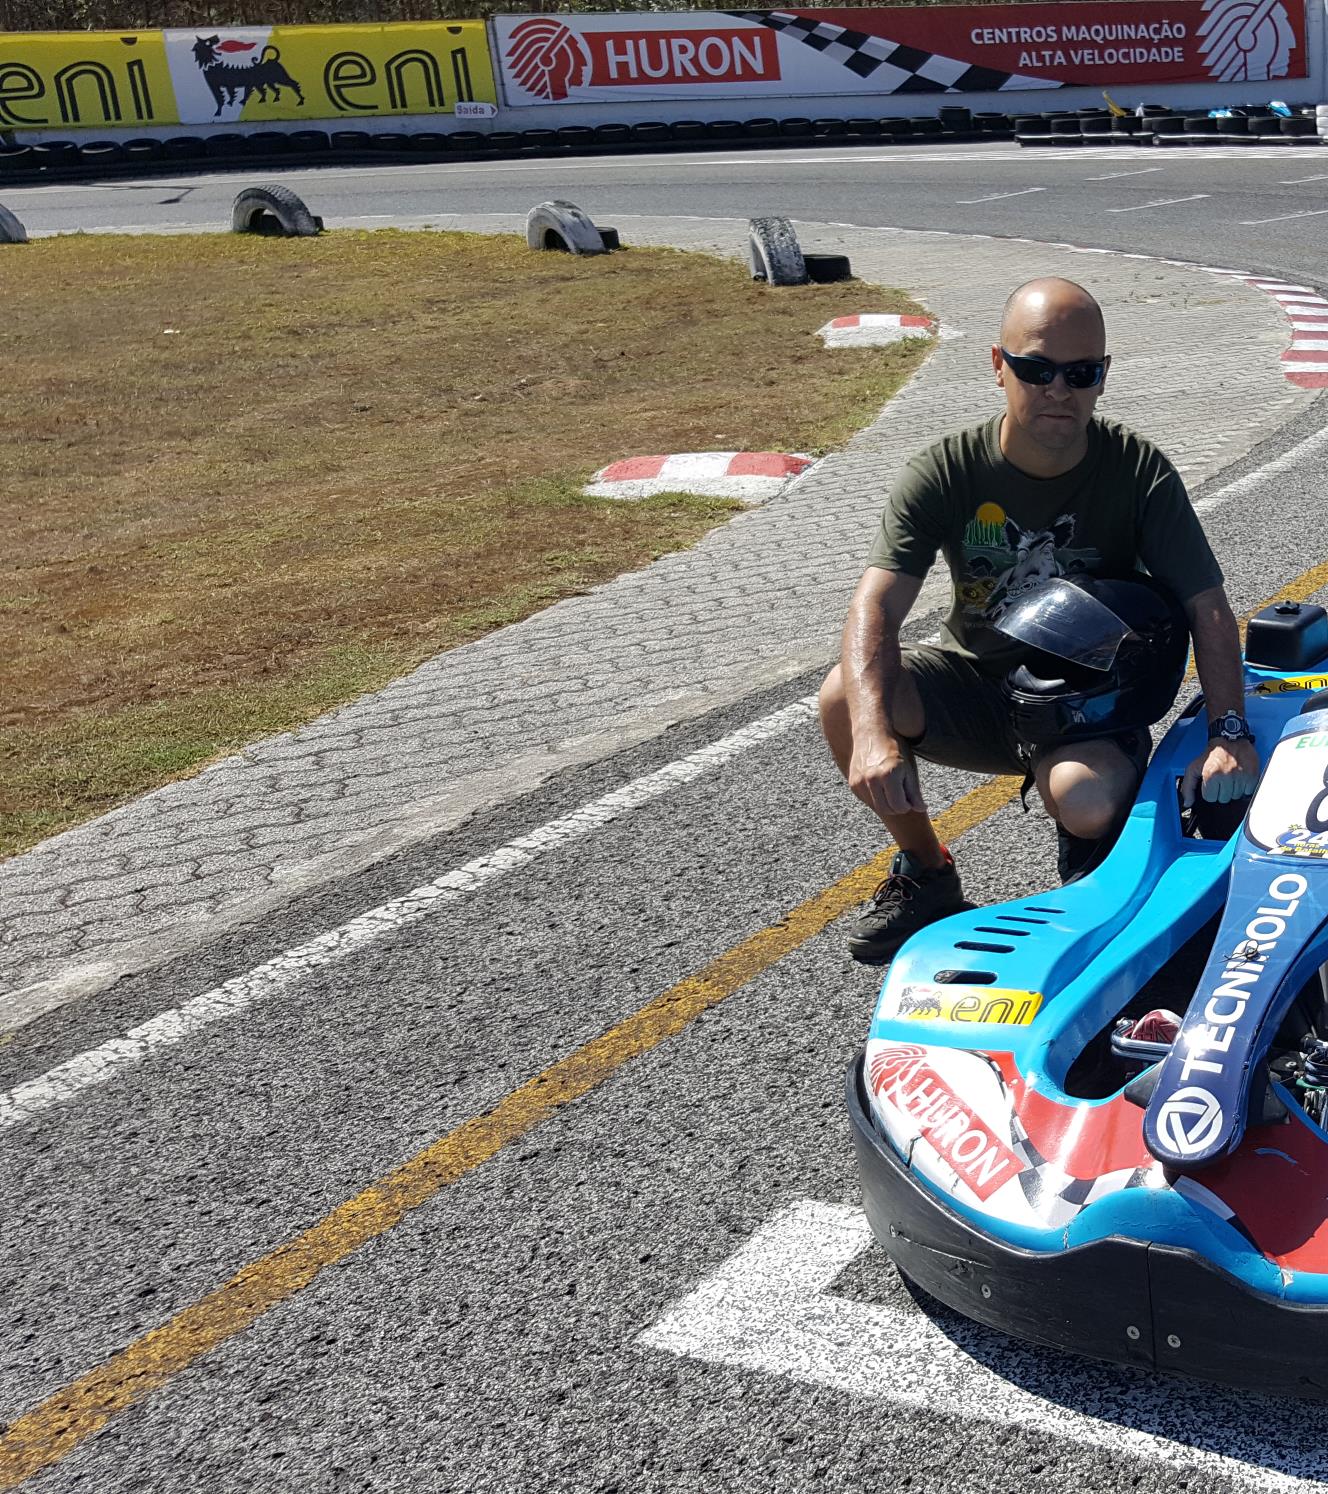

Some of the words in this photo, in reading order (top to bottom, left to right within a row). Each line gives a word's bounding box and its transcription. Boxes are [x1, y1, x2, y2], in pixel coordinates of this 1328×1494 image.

[605, 36, 765, 79] HURON
[970, 25, 1058, 45] CENTROS
[1061, 20, 1187, 43] MAQUINAÇÃO
[1018, 50, 1067, 68] ALTA
[1069, 47, 1185, 65] VELOCIDADE
[0, 36, 155, 126] eni
[324, 26, 474, 111] eni
[950, 991, 1033, 1025] eni
[1180, 873, 1308, 1081] TECNIROLO
[905, 1077, 1010, 1188] HURON
